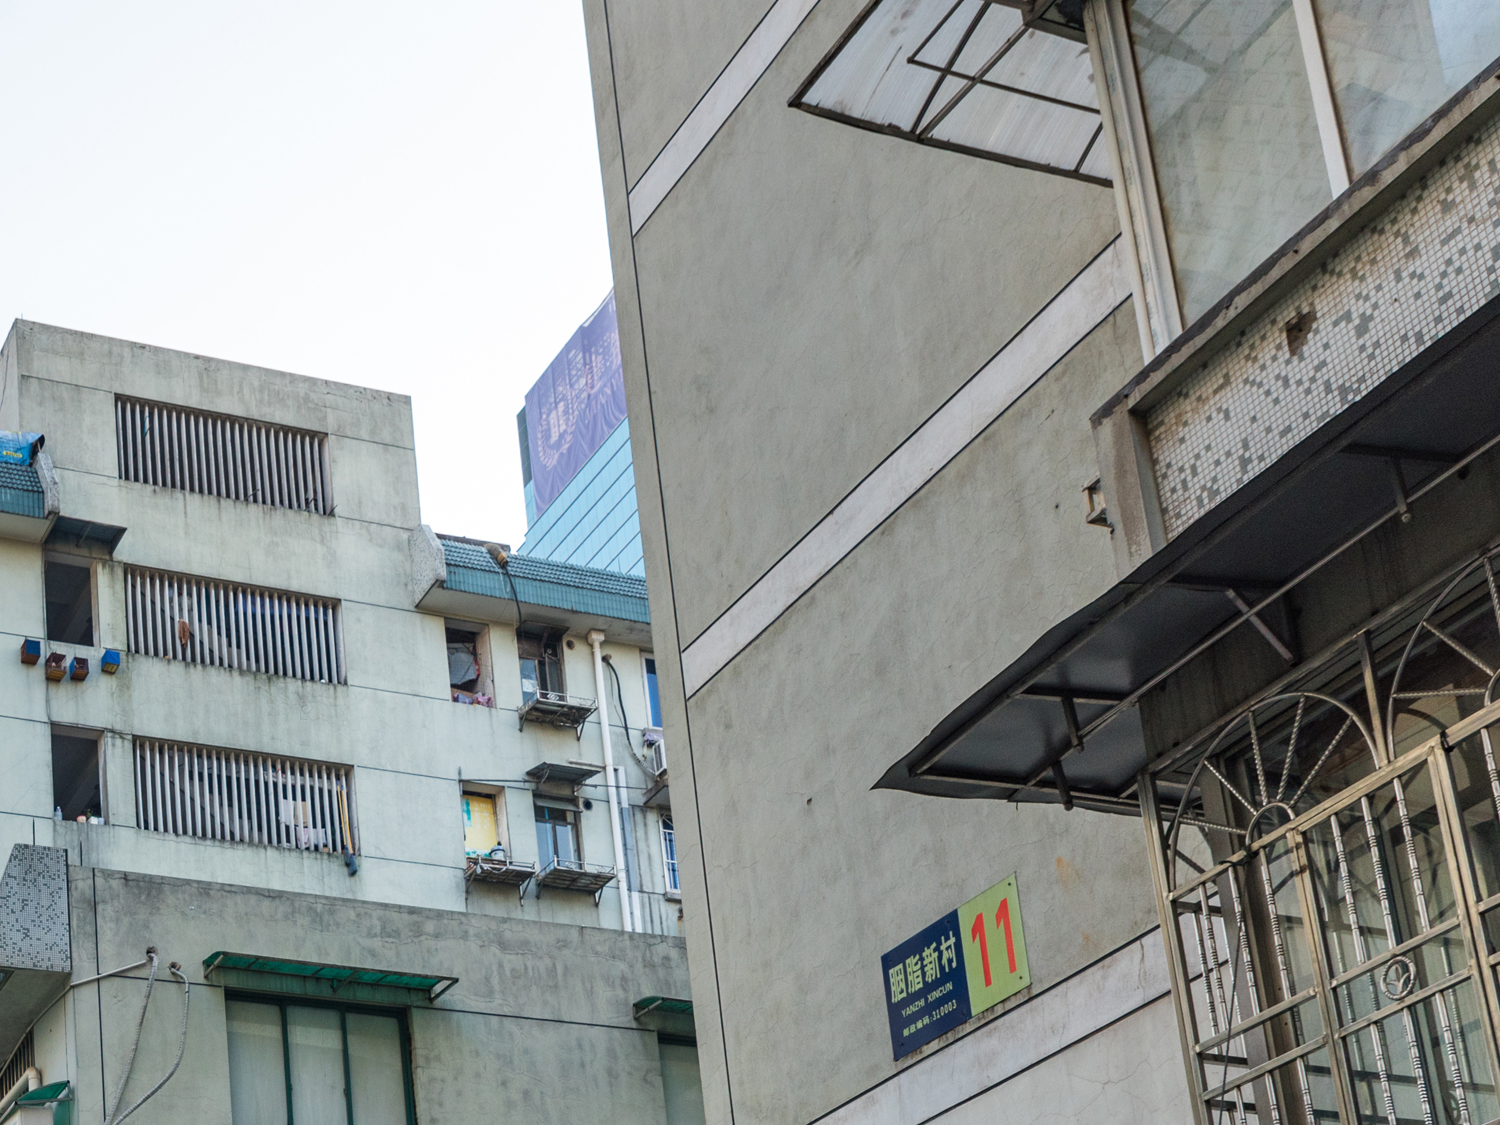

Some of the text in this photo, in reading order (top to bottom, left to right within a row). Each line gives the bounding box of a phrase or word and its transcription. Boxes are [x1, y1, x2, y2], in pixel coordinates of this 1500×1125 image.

[888, 930, 958, 1004] 胭脂新村
[971, 897, 1017, 988] 11
[901, 981, 953, 1018] YANZHI XINCUN
